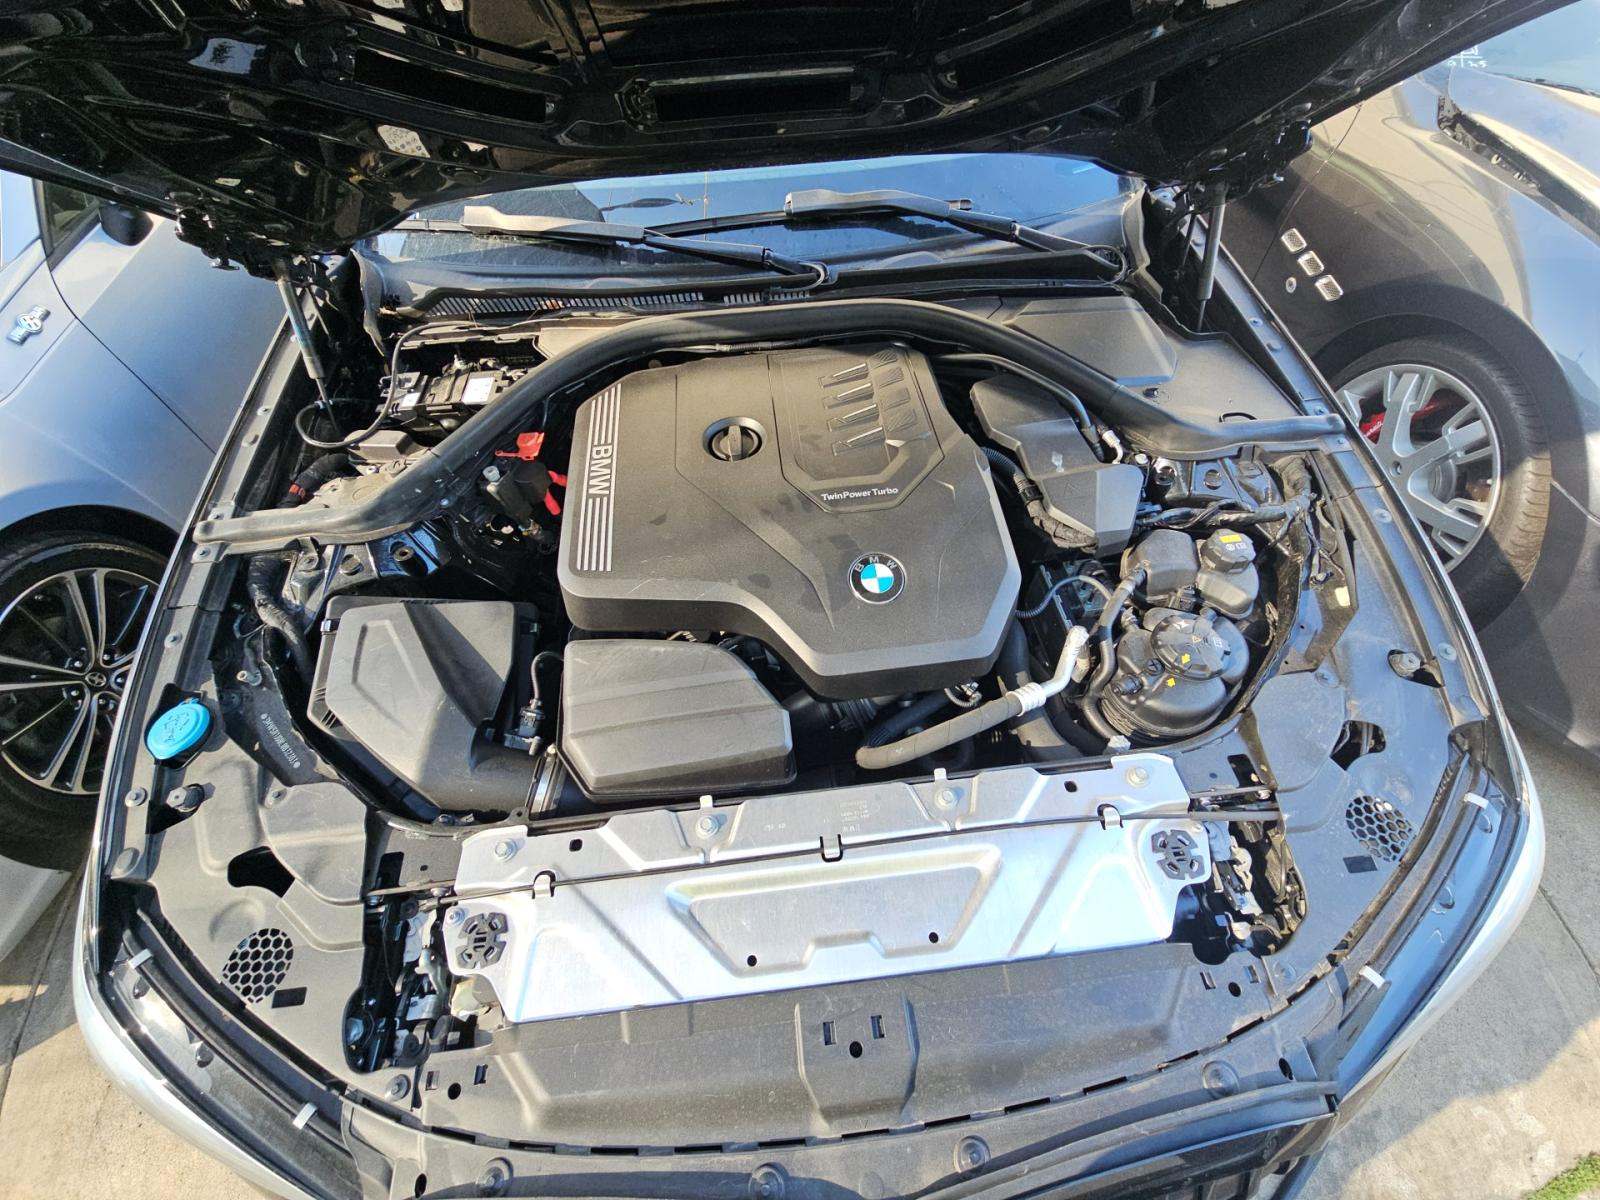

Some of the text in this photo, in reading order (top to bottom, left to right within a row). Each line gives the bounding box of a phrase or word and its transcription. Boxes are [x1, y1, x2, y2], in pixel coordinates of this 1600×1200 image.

[588, 443, 613, 495] BMW
[821, 487, 899, 501] TwinPower Turbo
[855, 555, 898, 573] BMW
